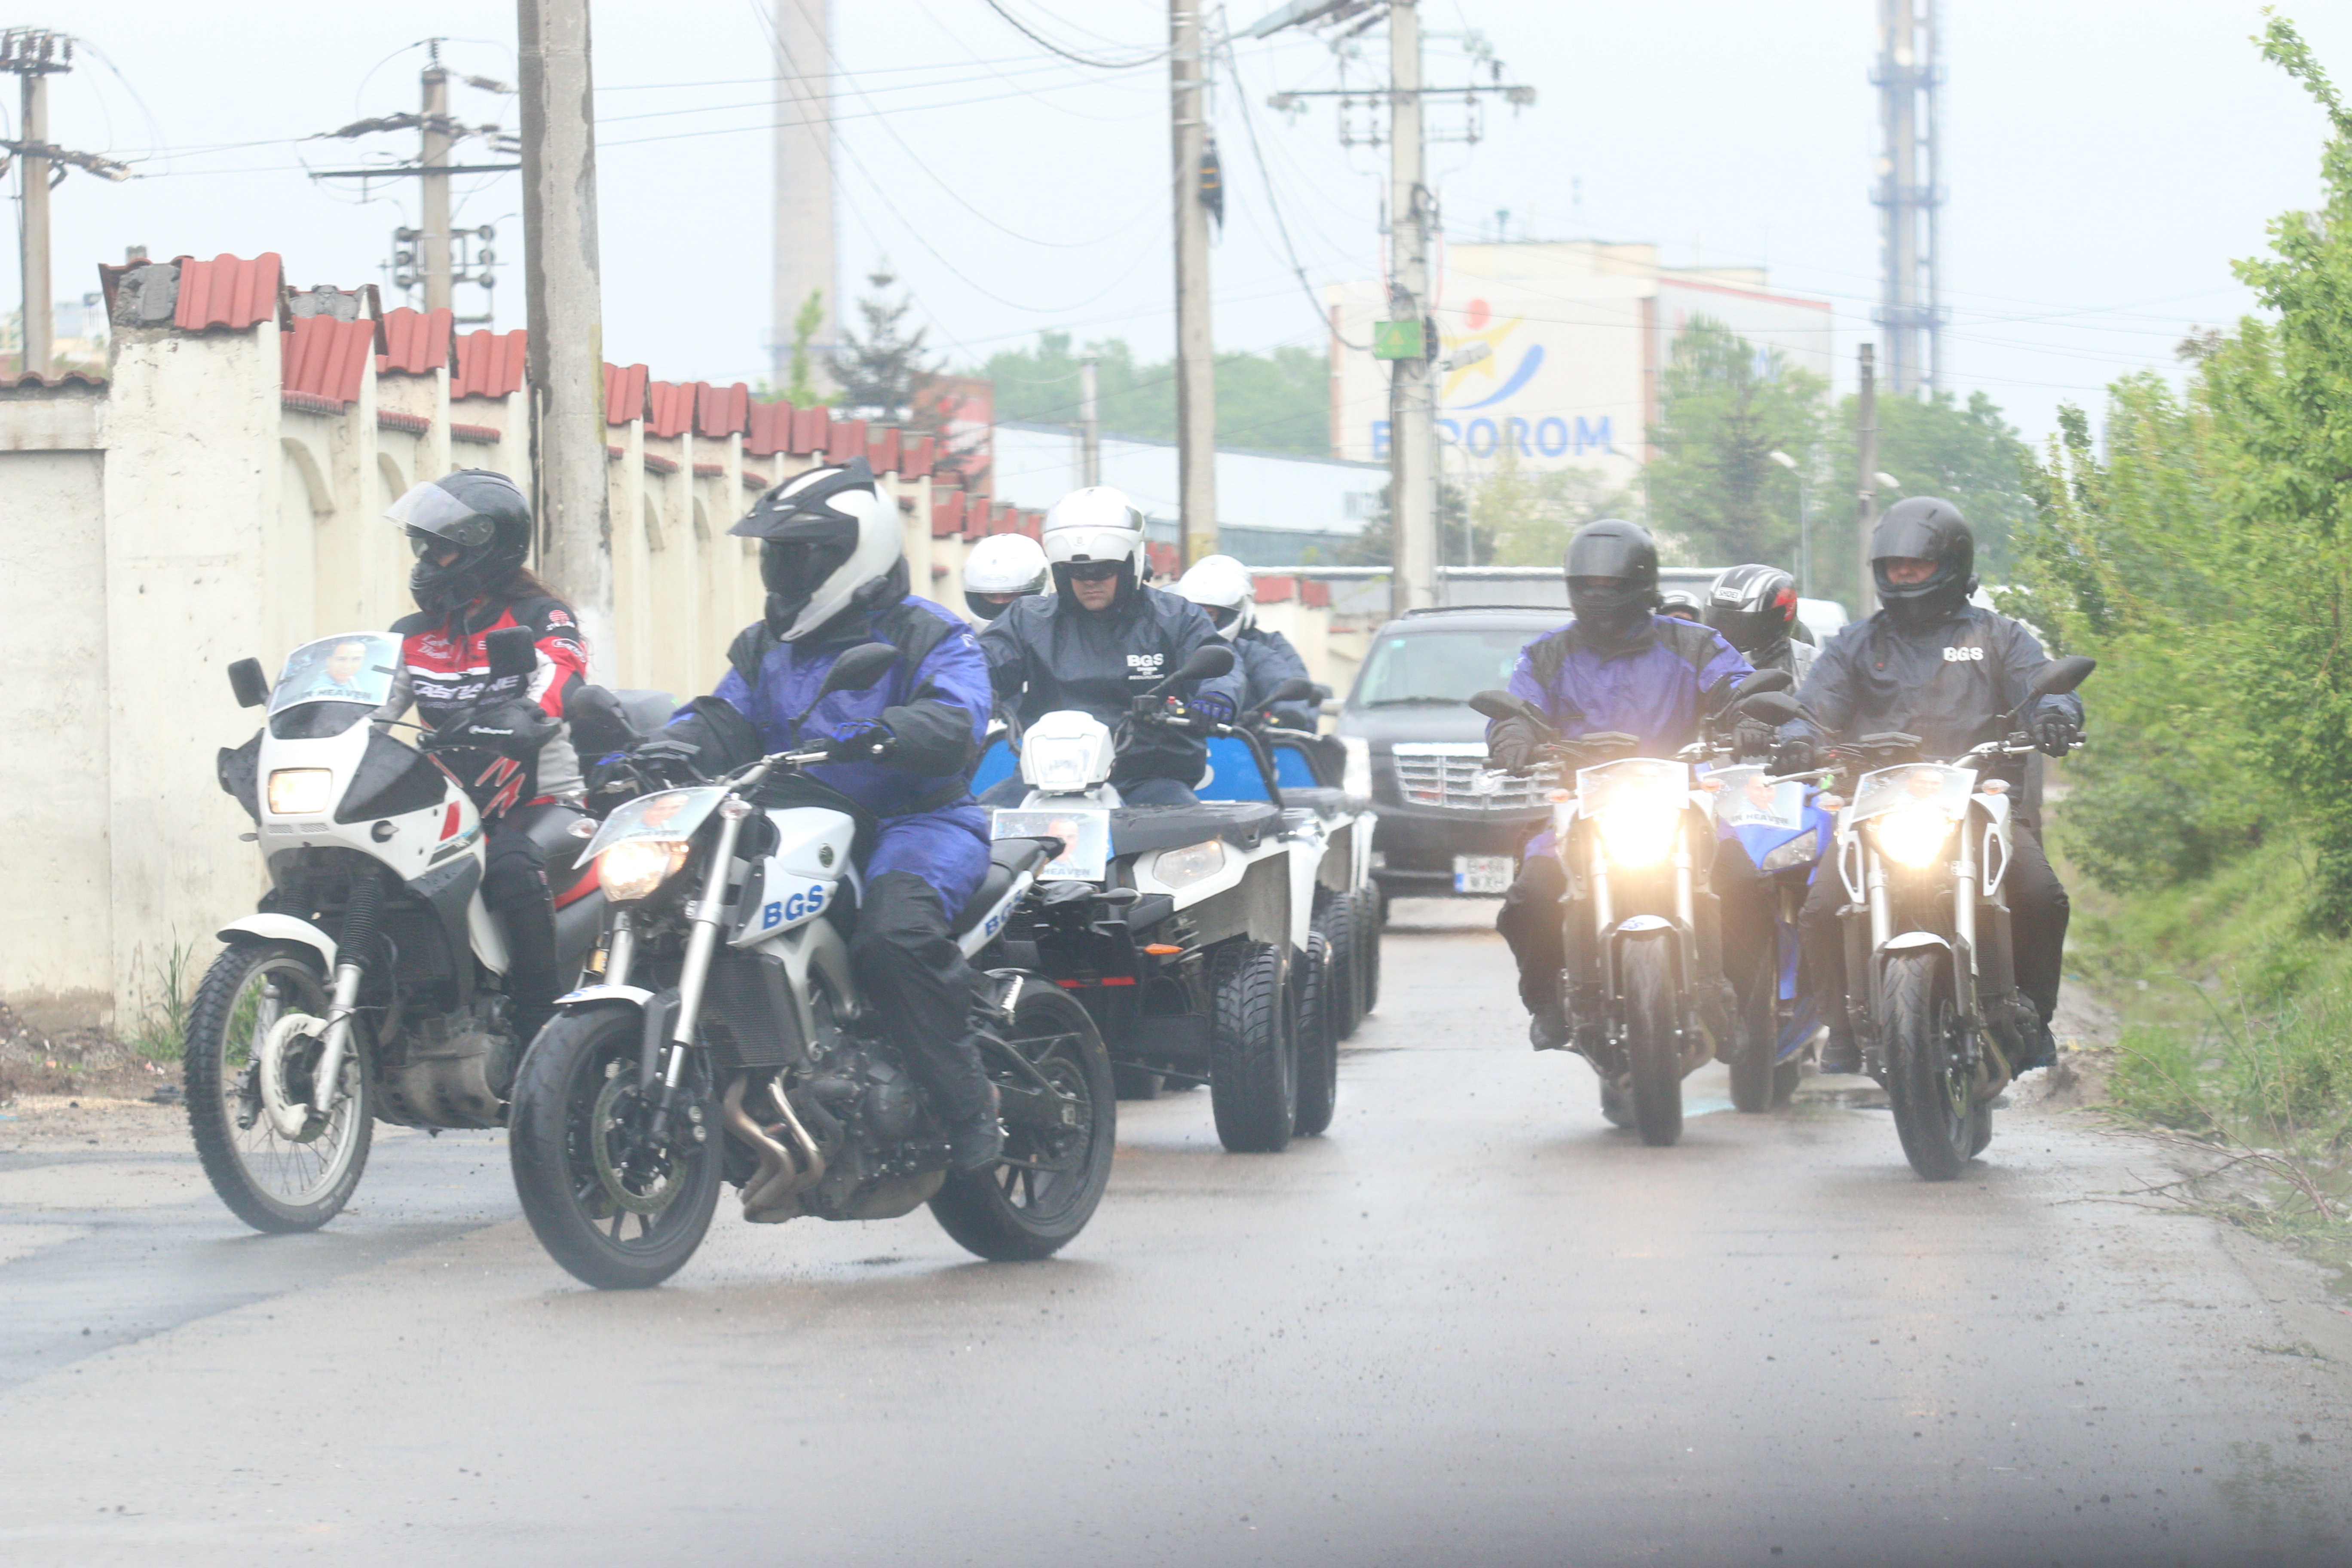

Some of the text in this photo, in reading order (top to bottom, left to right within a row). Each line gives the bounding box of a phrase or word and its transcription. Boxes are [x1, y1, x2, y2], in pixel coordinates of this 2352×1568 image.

[1719, 590, 1738, 598] SHOEI
[1127, 653, 1164, 667] BGS
[1942, 646, 1984, 662] BGS
[1746, 814, 1789, 825] HEAVEN
[763, 885, 824, 929] BGS
